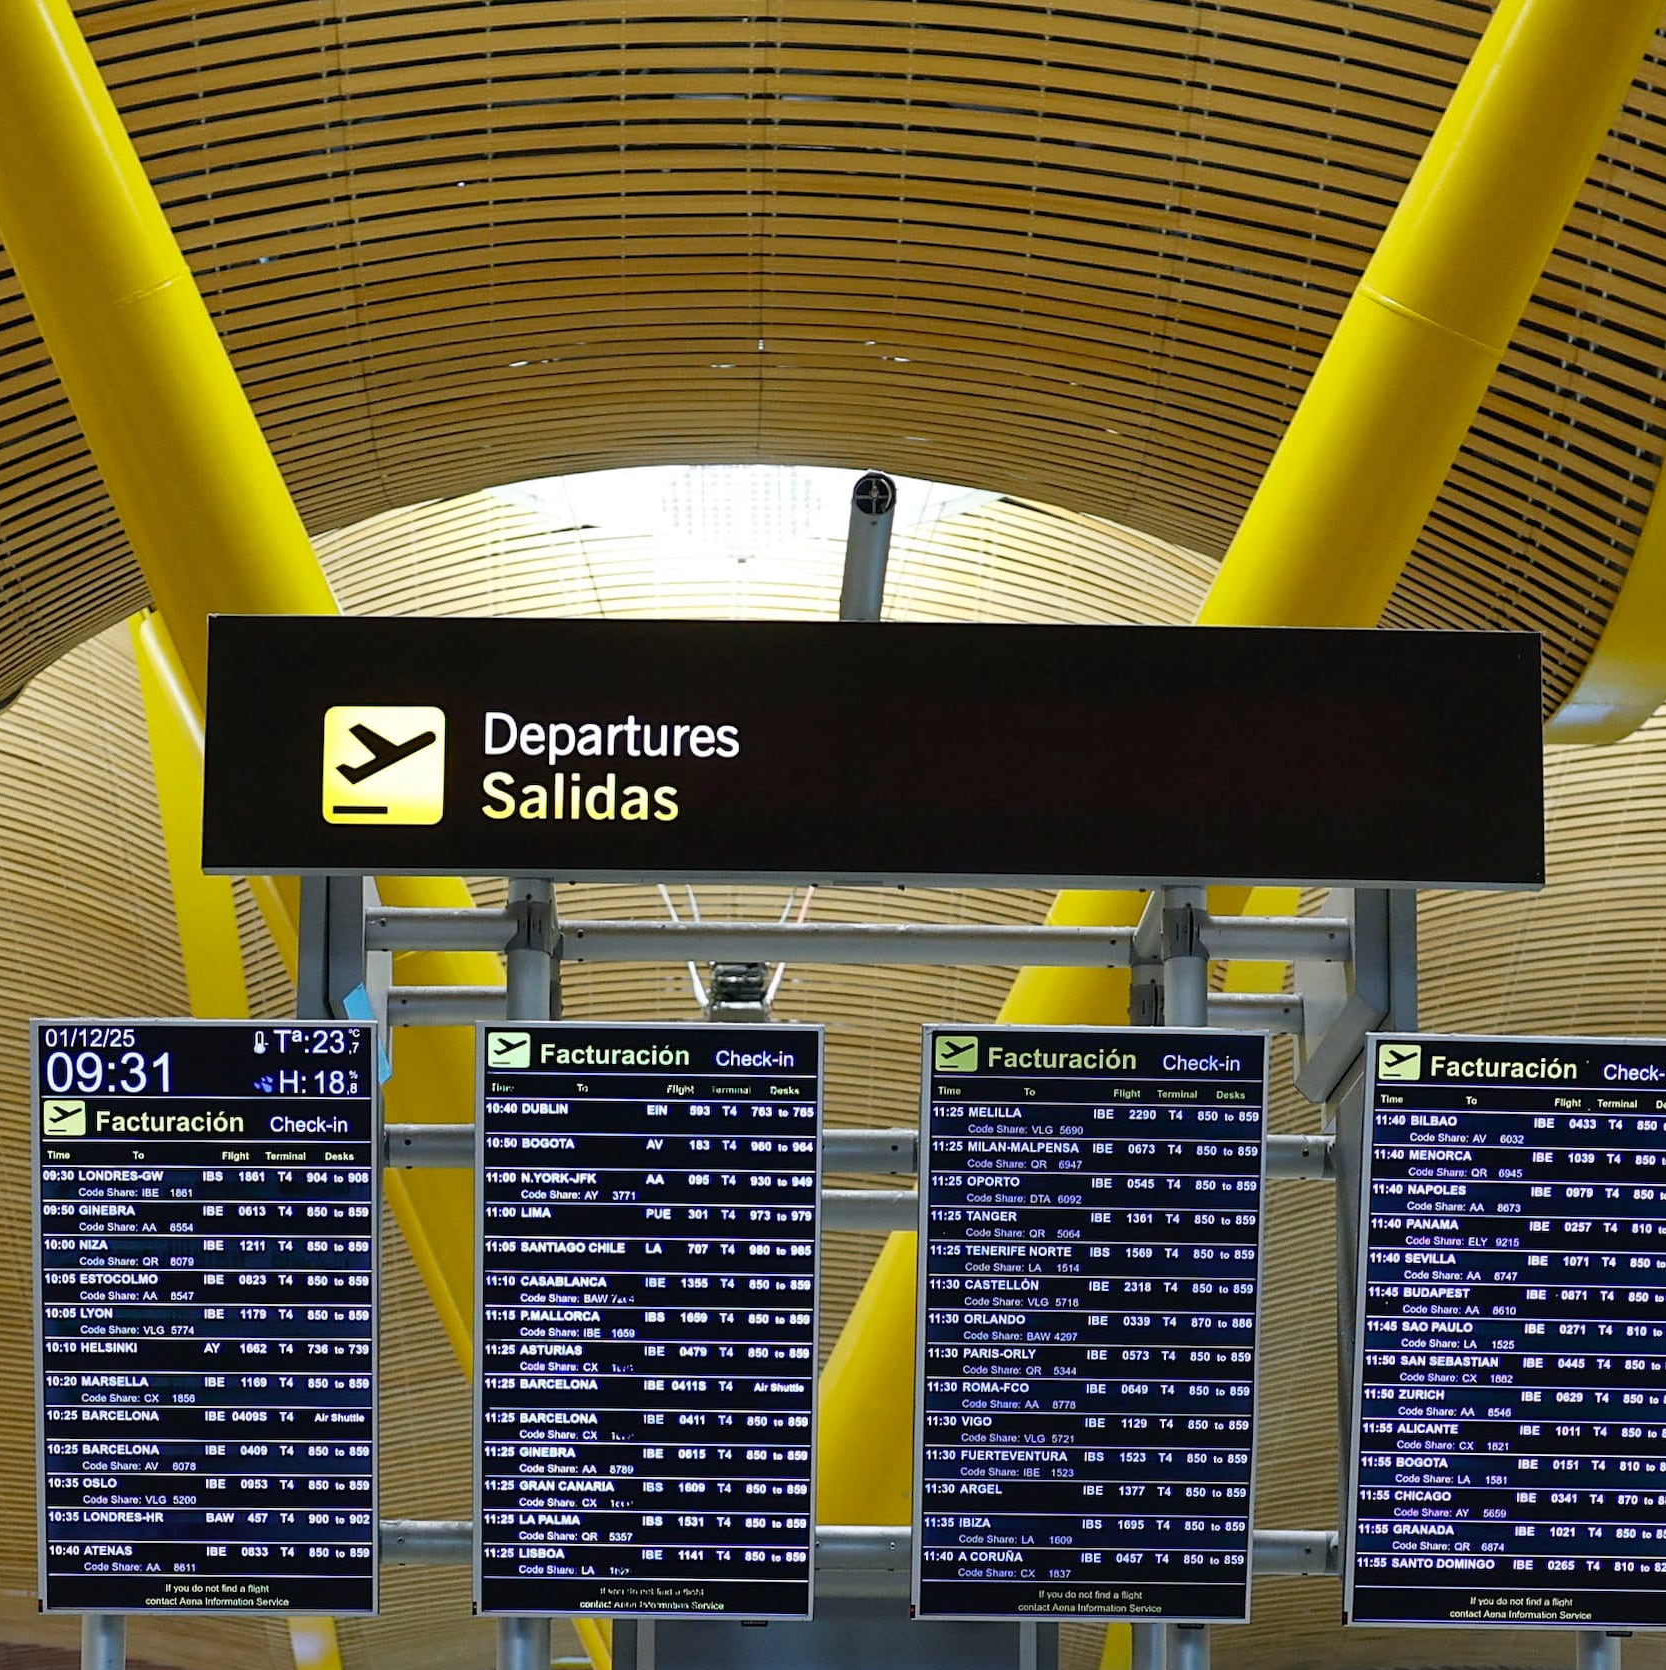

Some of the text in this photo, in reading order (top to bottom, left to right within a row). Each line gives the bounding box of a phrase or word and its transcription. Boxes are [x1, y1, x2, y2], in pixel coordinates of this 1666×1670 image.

[485, 712, 739, 765] Departures
[483, 771, 679, 821] Salidas
[45, 1029, 135, 1048] 01/12/25
[540, 1043, 794, 1067] Facturación Check-in
[988, 1047, 1240, 1071] Facturación Check-in
[47, 1052, 170, 1093] 09:31
[280, 1070, 306, 1094] H:
[1431, 1056, 1577, 1080] Facturación
[486, 1104, 568, 1114] 10:40 DUBLIN
[96, 1111, 348, 1133] Facturación Check-in
[1376, 1115, 1457, 1126] 11:40 BILBAO
[933, 1142, 1079, 1153] 11:25 MILAN-MALPENSA
[47, 1151, 354, 1161] Time To Flight Terminal Desks
[43, 1171, 74, 1181] 09:30
[78, 1171, 164, 1181] LONDRES-GW
[203, 1172, 223, 1182] IBS
[278, 1172, 292, 1182] T4
[307, 1173, 327, 1183] 904
[334, 1175, 344, 1183] to
[486, 1242, 625, 1253] 11:05 SANTIAGO CHILE
[45, 1274, 158, 1284] 10:05 ESTOCOLMO
[930, 1278, 1039, 1291] 11:30 CASTELLÓN
[1368, 1287, 1470, 1298] 11:45 BUDAPEST
[146, 1597, 289, 1606] contact Aena Information Service
